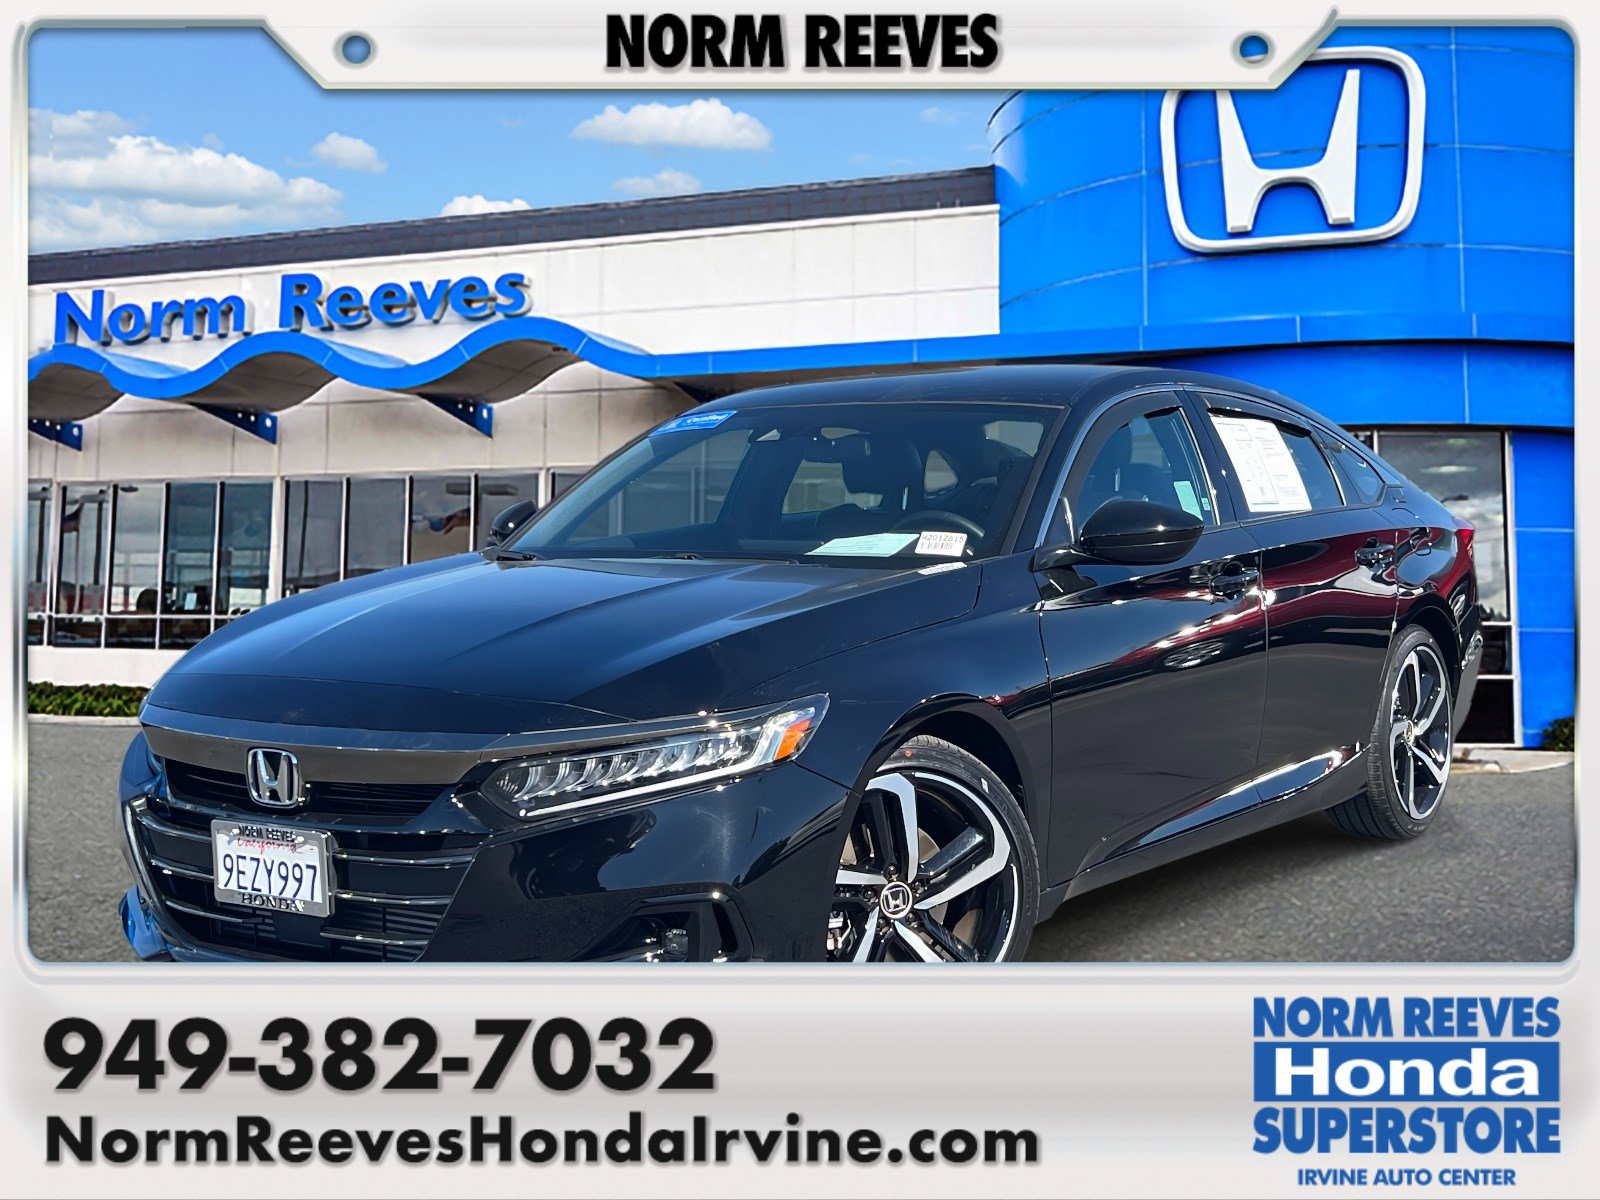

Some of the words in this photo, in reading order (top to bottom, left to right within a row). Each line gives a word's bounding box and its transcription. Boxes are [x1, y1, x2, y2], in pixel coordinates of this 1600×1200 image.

[54, 288, 248, 346] Norm
[278, 272, 530, 329] Reeves
[222, 853, 318, 902] 9EZY997
[240, 892, 305, 912] HONDA
